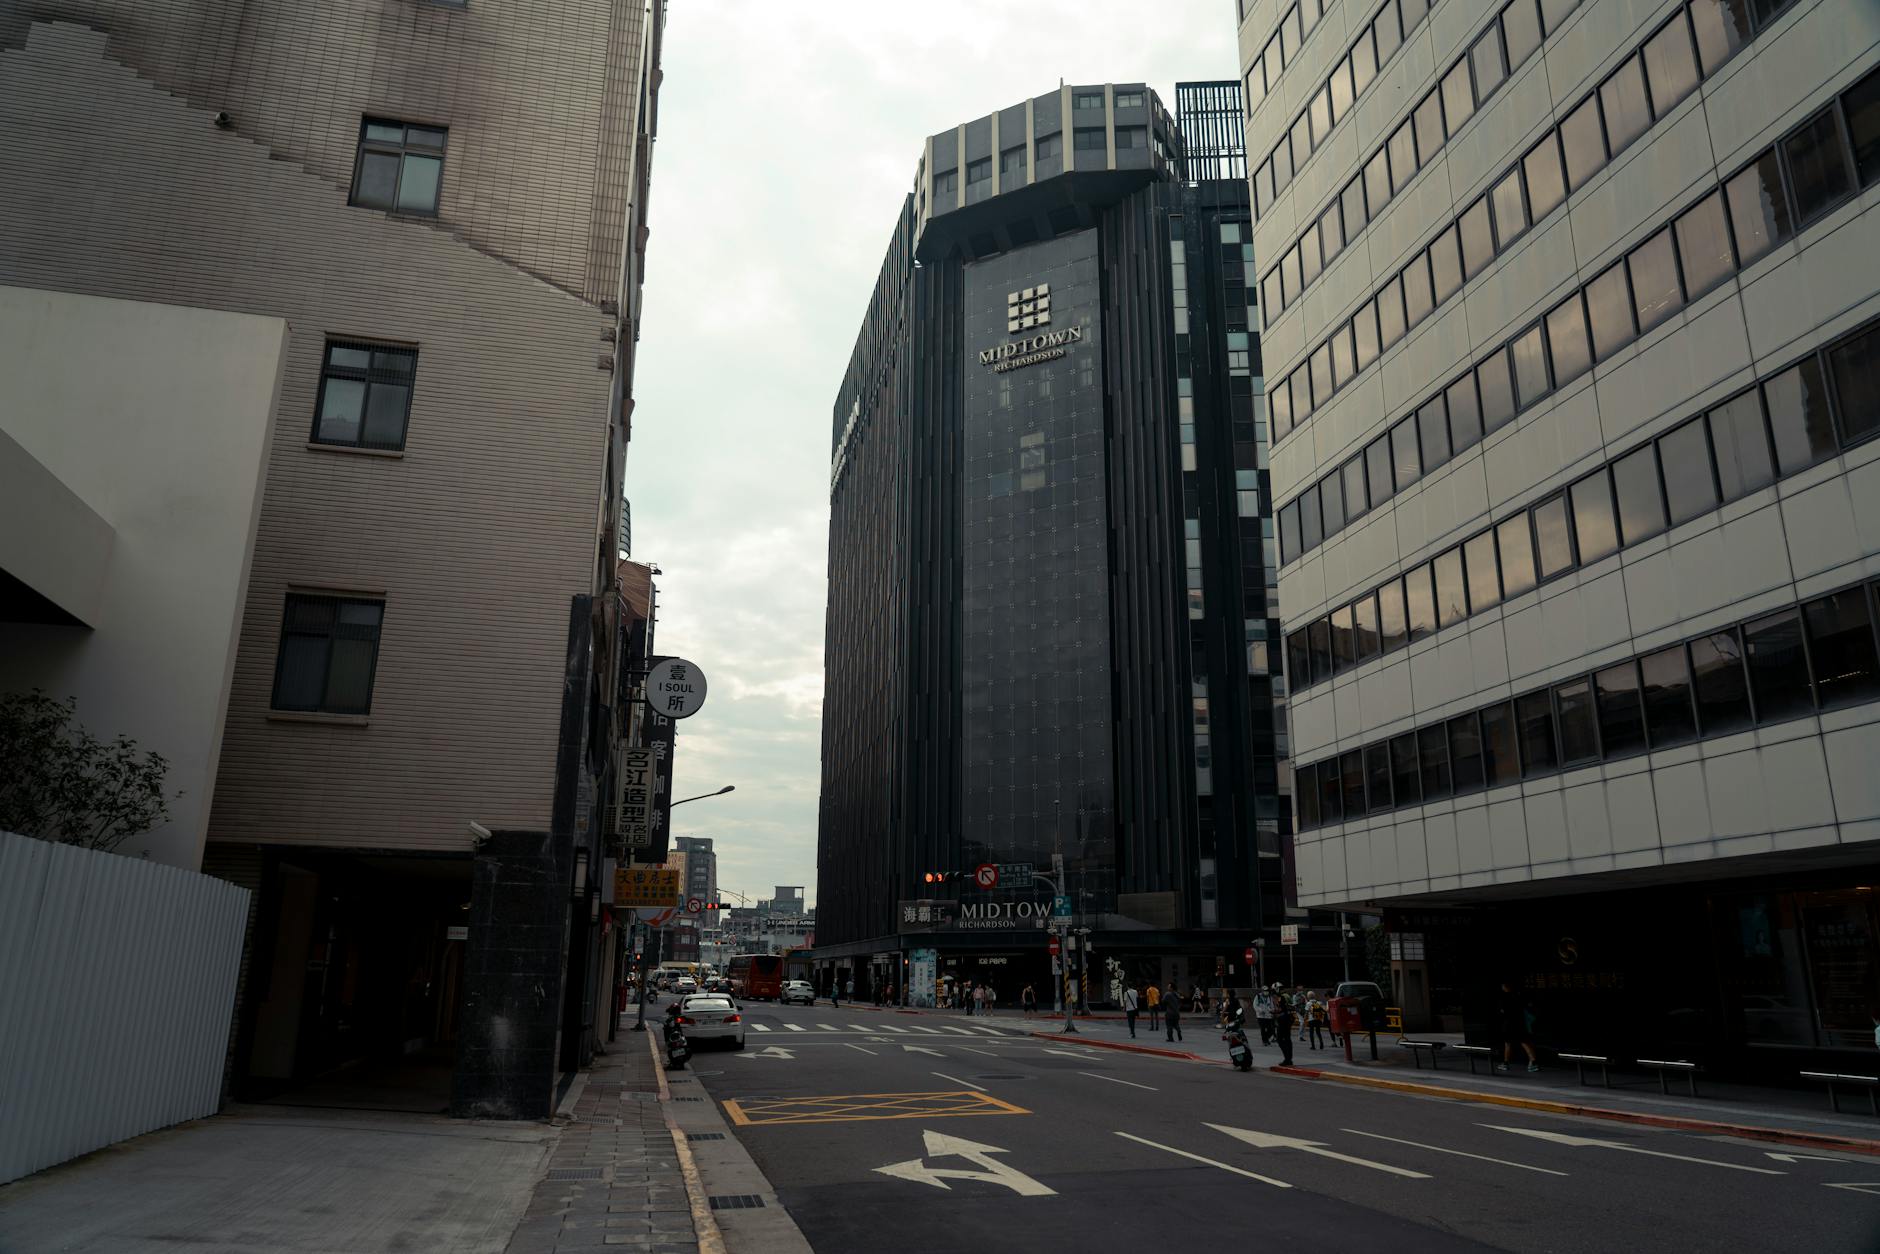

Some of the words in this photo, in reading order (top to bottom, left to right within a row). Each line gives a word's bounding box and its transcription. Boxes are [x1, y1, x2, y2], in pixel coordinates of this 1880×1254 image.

[979, 325, 1081, 364] MIDTOWN
[993, 347, 1064, 372] RICHARDSON
[670, 665, 686, 680] 壹
[665, 684, 694, 693] SOUL
[668, 696, 684, 711] 所
[624, 751, 649, 823] 名江造型
[961, 902, 1052, 919] MIDTOW
[1055, 898, 1064, 908] P
[904, 905, 946, 923] 海霸王
[959, 920, 1016, 929] RICHARDSON
